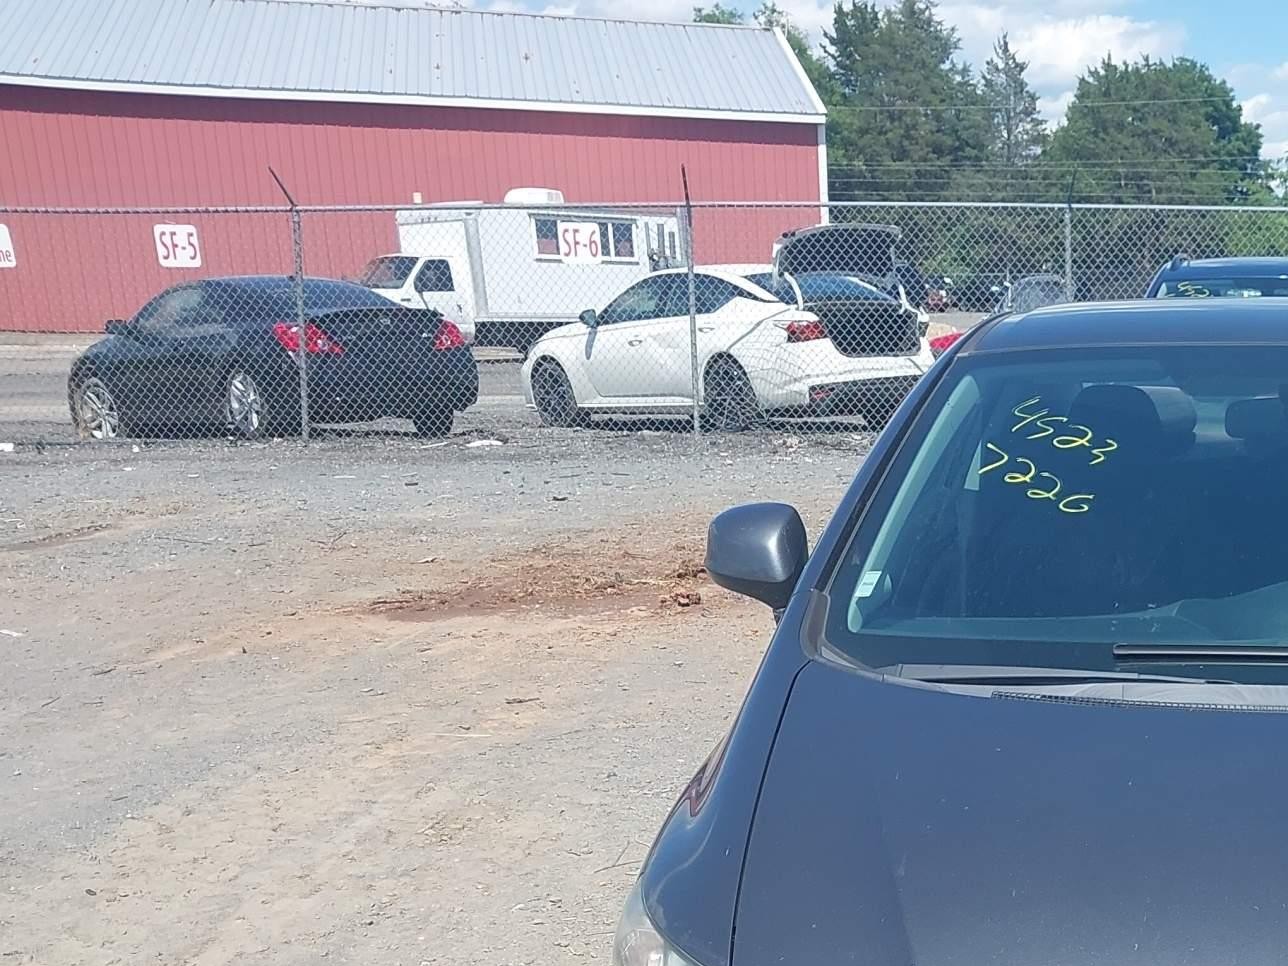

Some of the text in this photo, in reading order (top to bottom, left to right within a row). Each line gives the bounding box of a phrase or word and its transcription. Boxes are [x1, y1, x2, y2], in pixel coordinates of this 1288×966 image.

[159, 230, 198, 261] SF-5
[562, 228, 599, 258] SF-6
[1011, 395, 1118, 465] 4523
